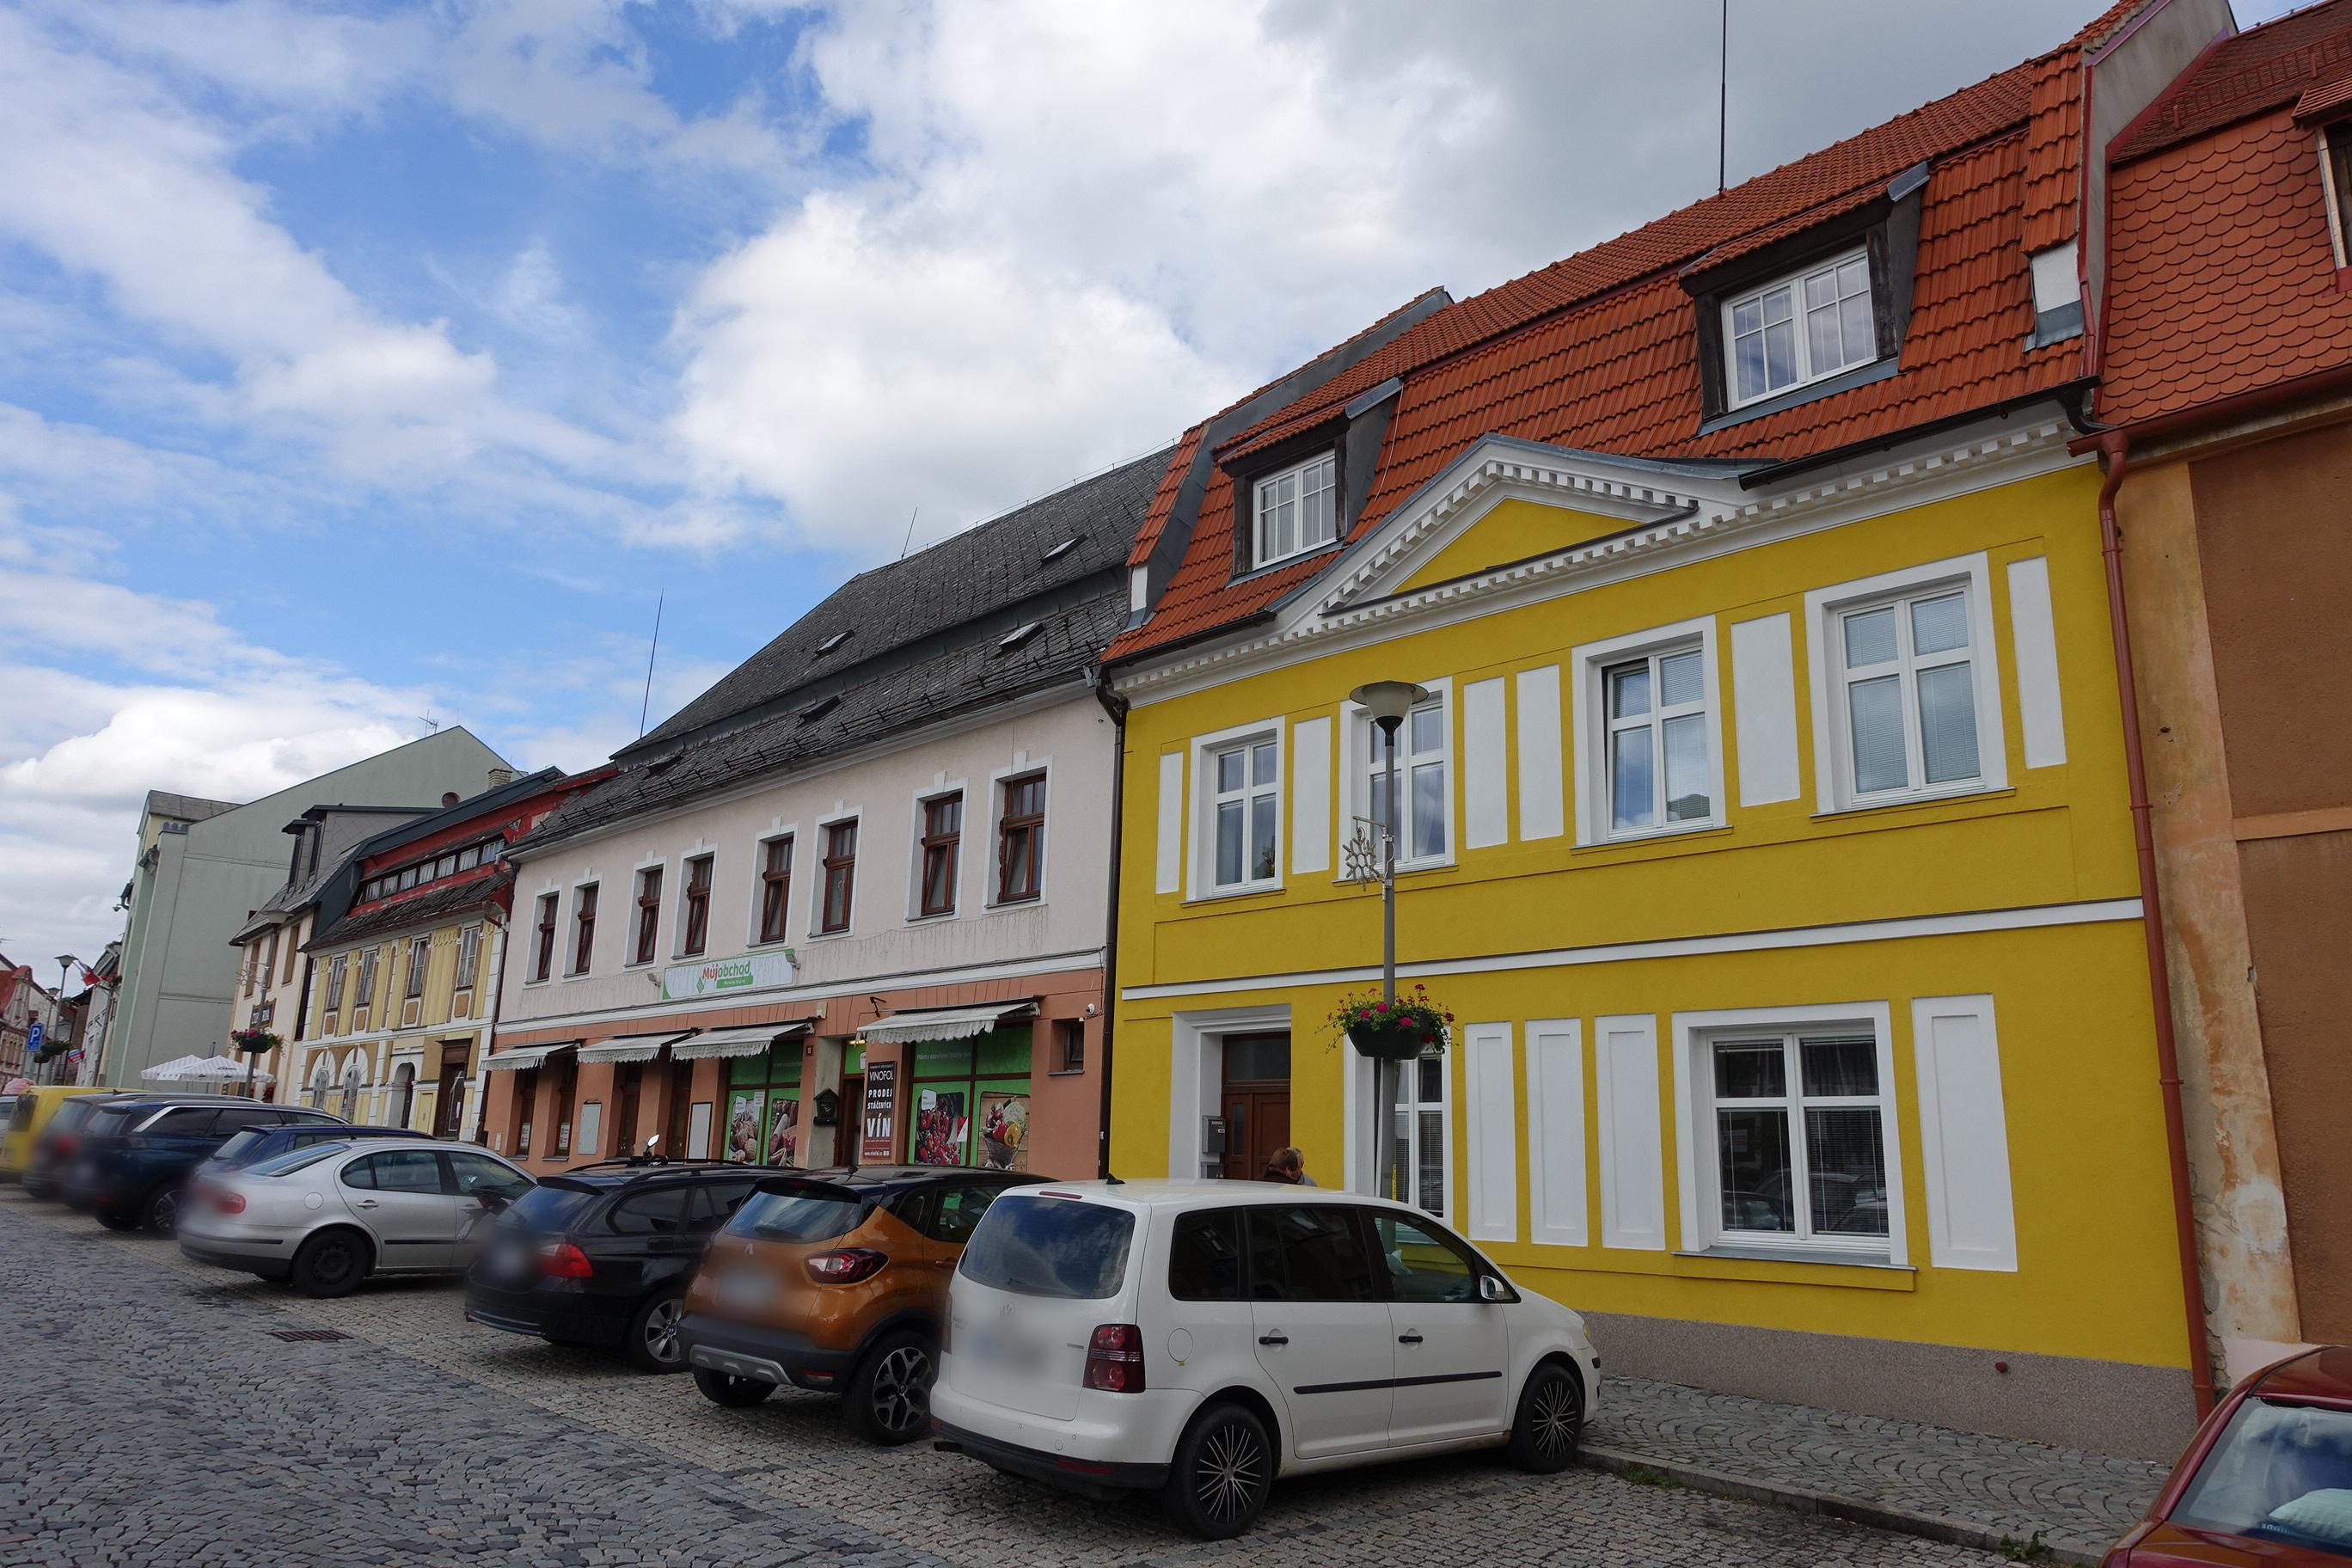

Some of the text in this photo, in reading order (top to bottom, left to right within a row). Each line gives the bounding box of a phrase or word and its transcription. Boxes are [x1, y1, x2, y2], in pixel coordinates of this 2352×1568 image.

[29, 1027, 40, 1043] P
[867, 1088, 893, 1099] PRODEJ
[867, 1100, 892, 1110] STÁČENÝCH
[867, 1112, 891, 1137] VÍN
